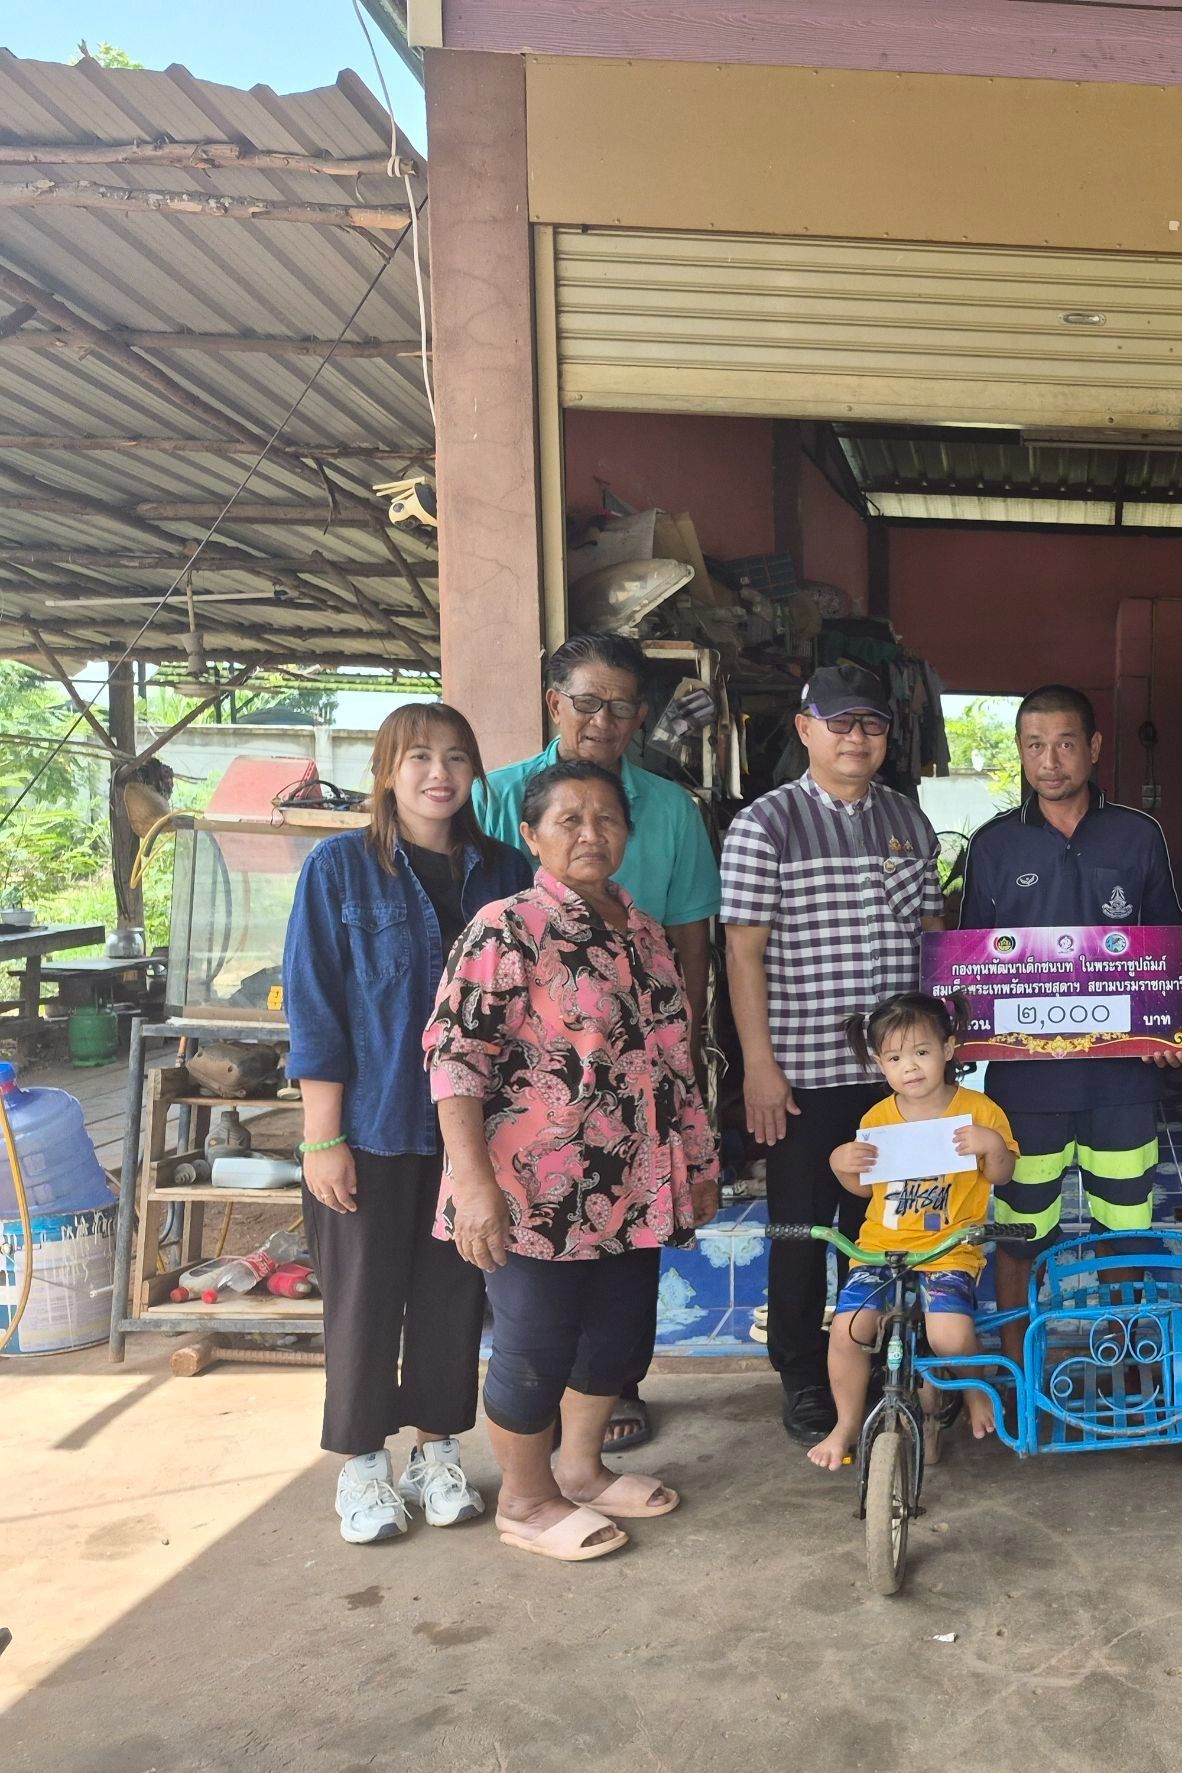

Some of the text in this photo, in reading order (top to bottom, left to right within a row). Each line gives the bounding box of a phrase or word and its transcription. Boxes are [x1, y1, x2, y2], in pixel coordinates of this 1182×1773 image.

[952, 954, 1167, 981] กองทุนพัฒนาเด็กชนบท ในพระราชูปถัมภ์
[1016, 1003, 1171, 1030] ๒,๐๐๐ บาท
